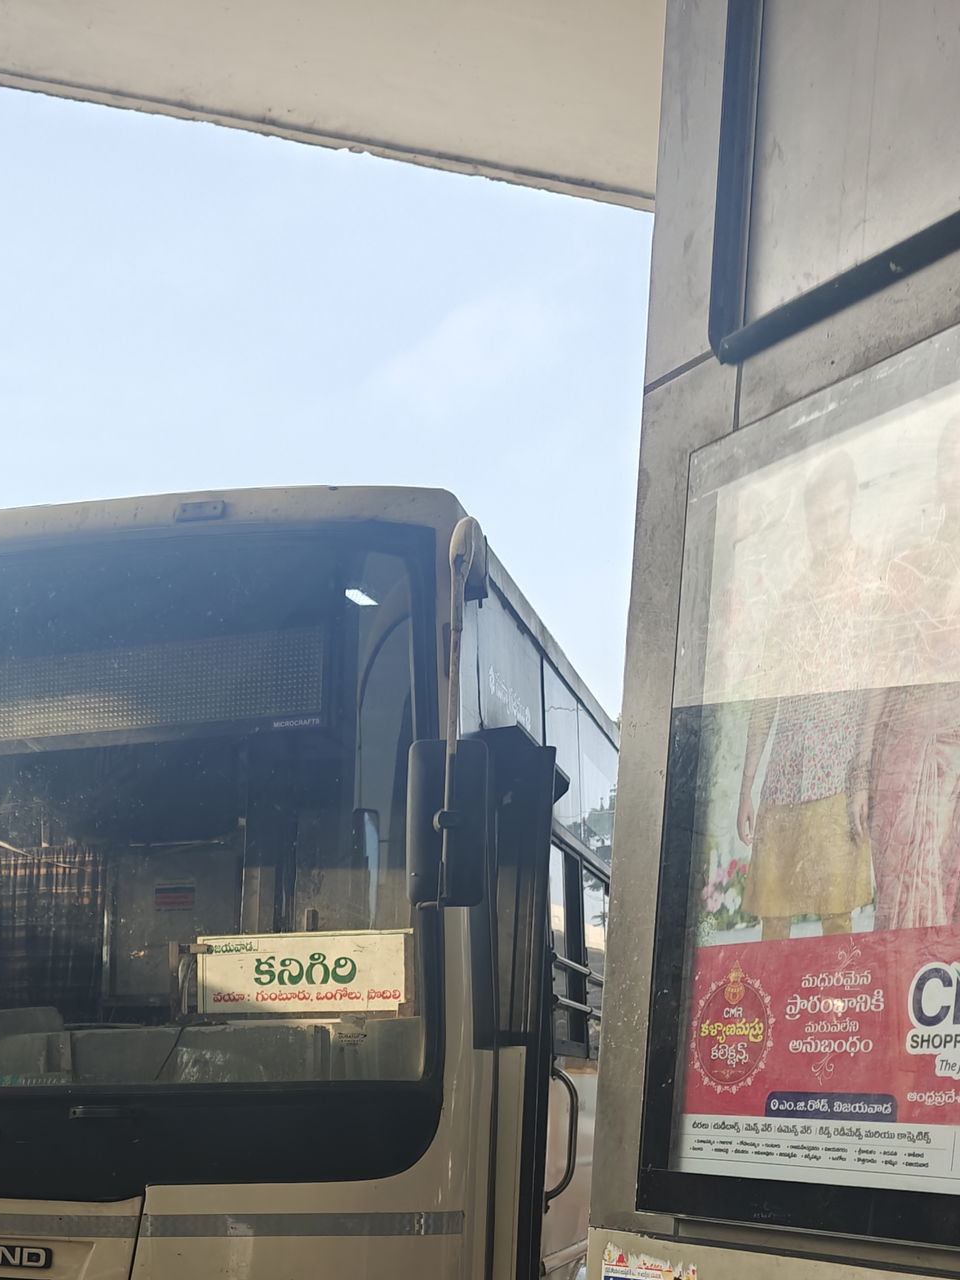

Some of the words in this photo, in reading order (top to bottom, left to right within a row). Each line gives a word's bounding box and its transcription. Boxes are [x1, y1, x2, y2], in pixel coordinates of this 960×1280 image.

[253, 952, 357, 987] కనిగిరి
[801, 970, 872, 990] మధురమైన
[723, 1006, 743, 1018] CMR
[788, 1036, 873, 1057] అనుబంధం
[939, 1059, 957, 1071] The
[833, 1100, 892, 1114] విజయవాడ
